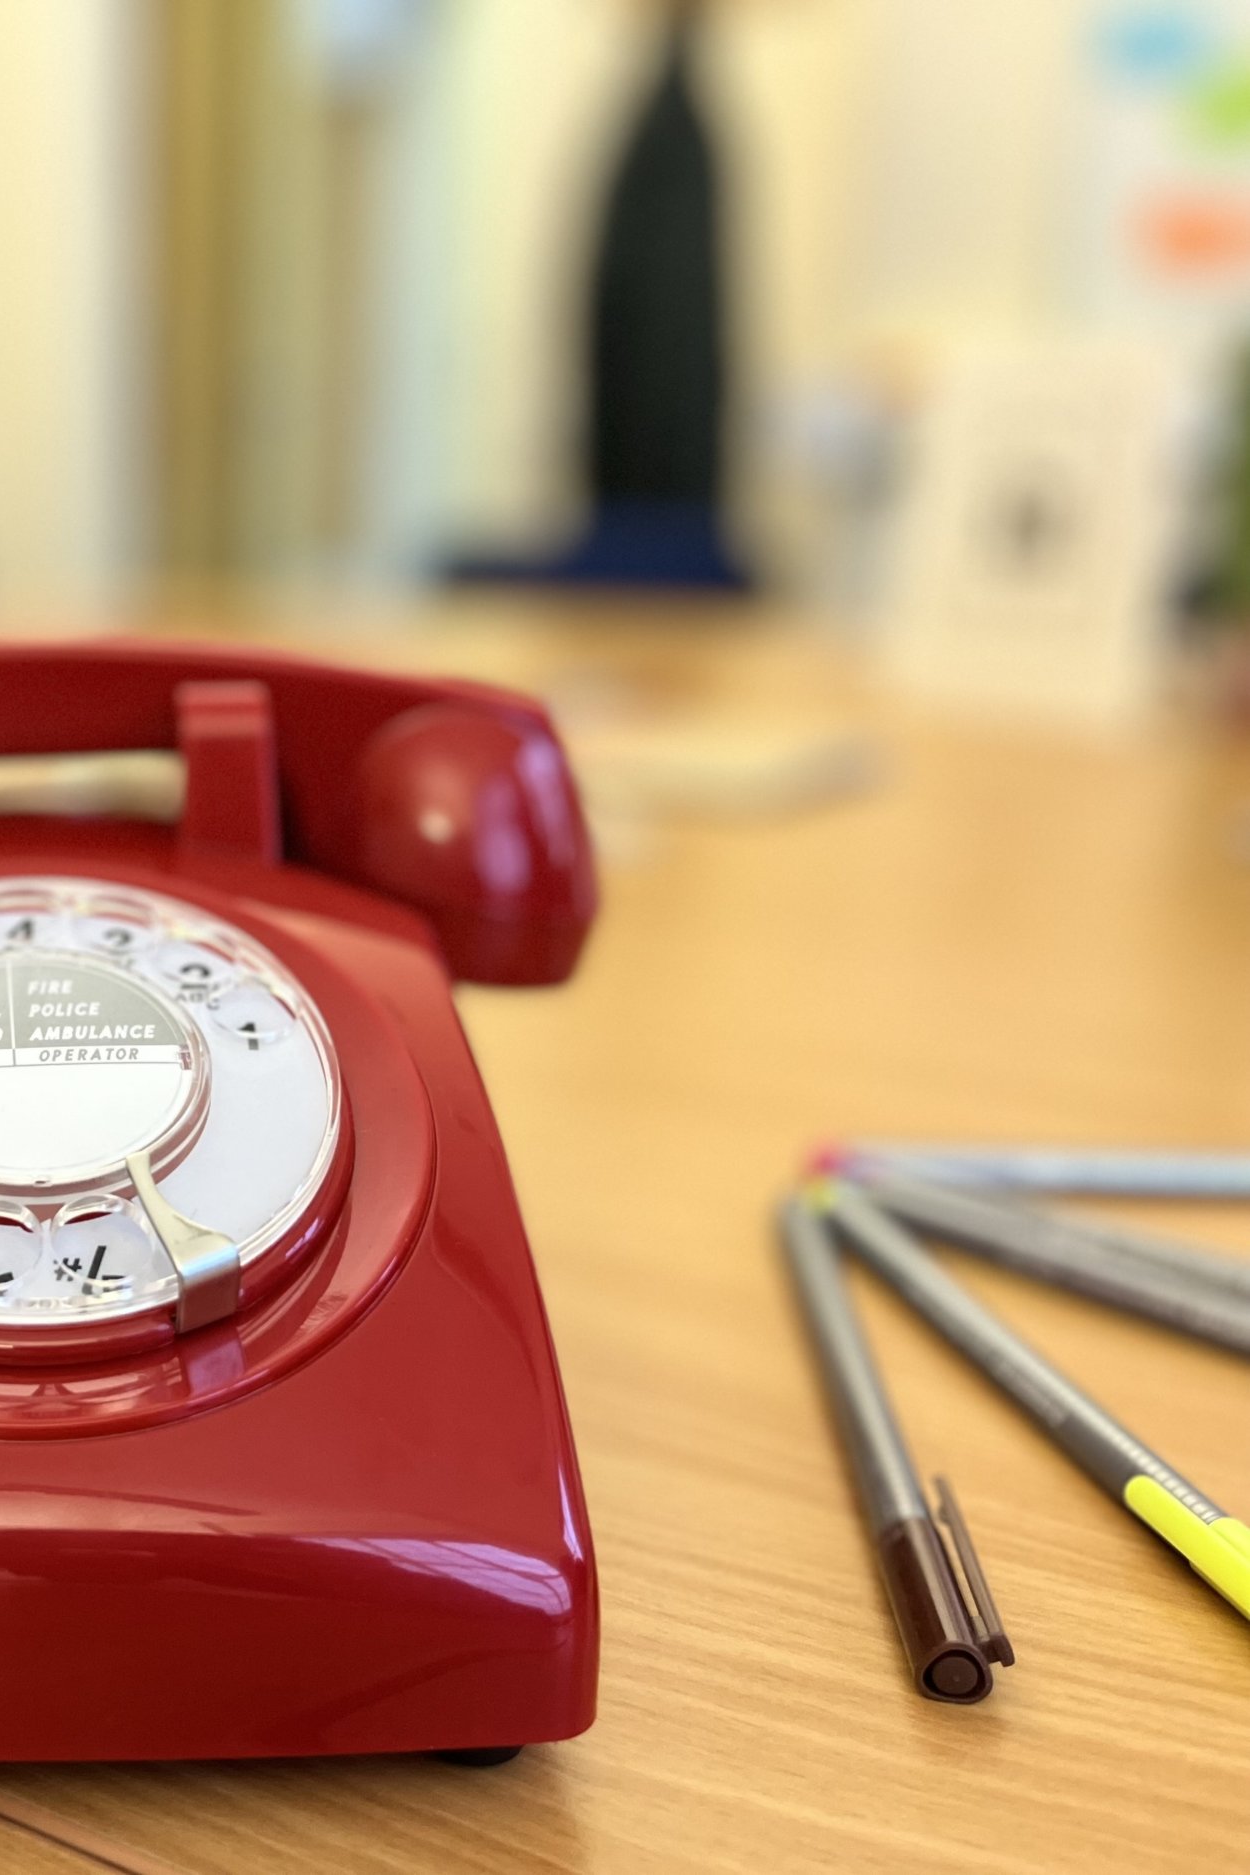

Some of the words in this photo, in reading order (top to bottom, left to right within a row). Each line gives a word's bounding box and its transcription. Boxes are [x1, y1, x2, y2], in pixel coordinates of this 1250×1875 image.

[27, 979, 73, 995] FIRE
[27, 1002, 101, 1018] POLICE
[29, 1024, 157, 1042] AMBULANCE
[38, 1047, 140, 1062] OPERATOR
